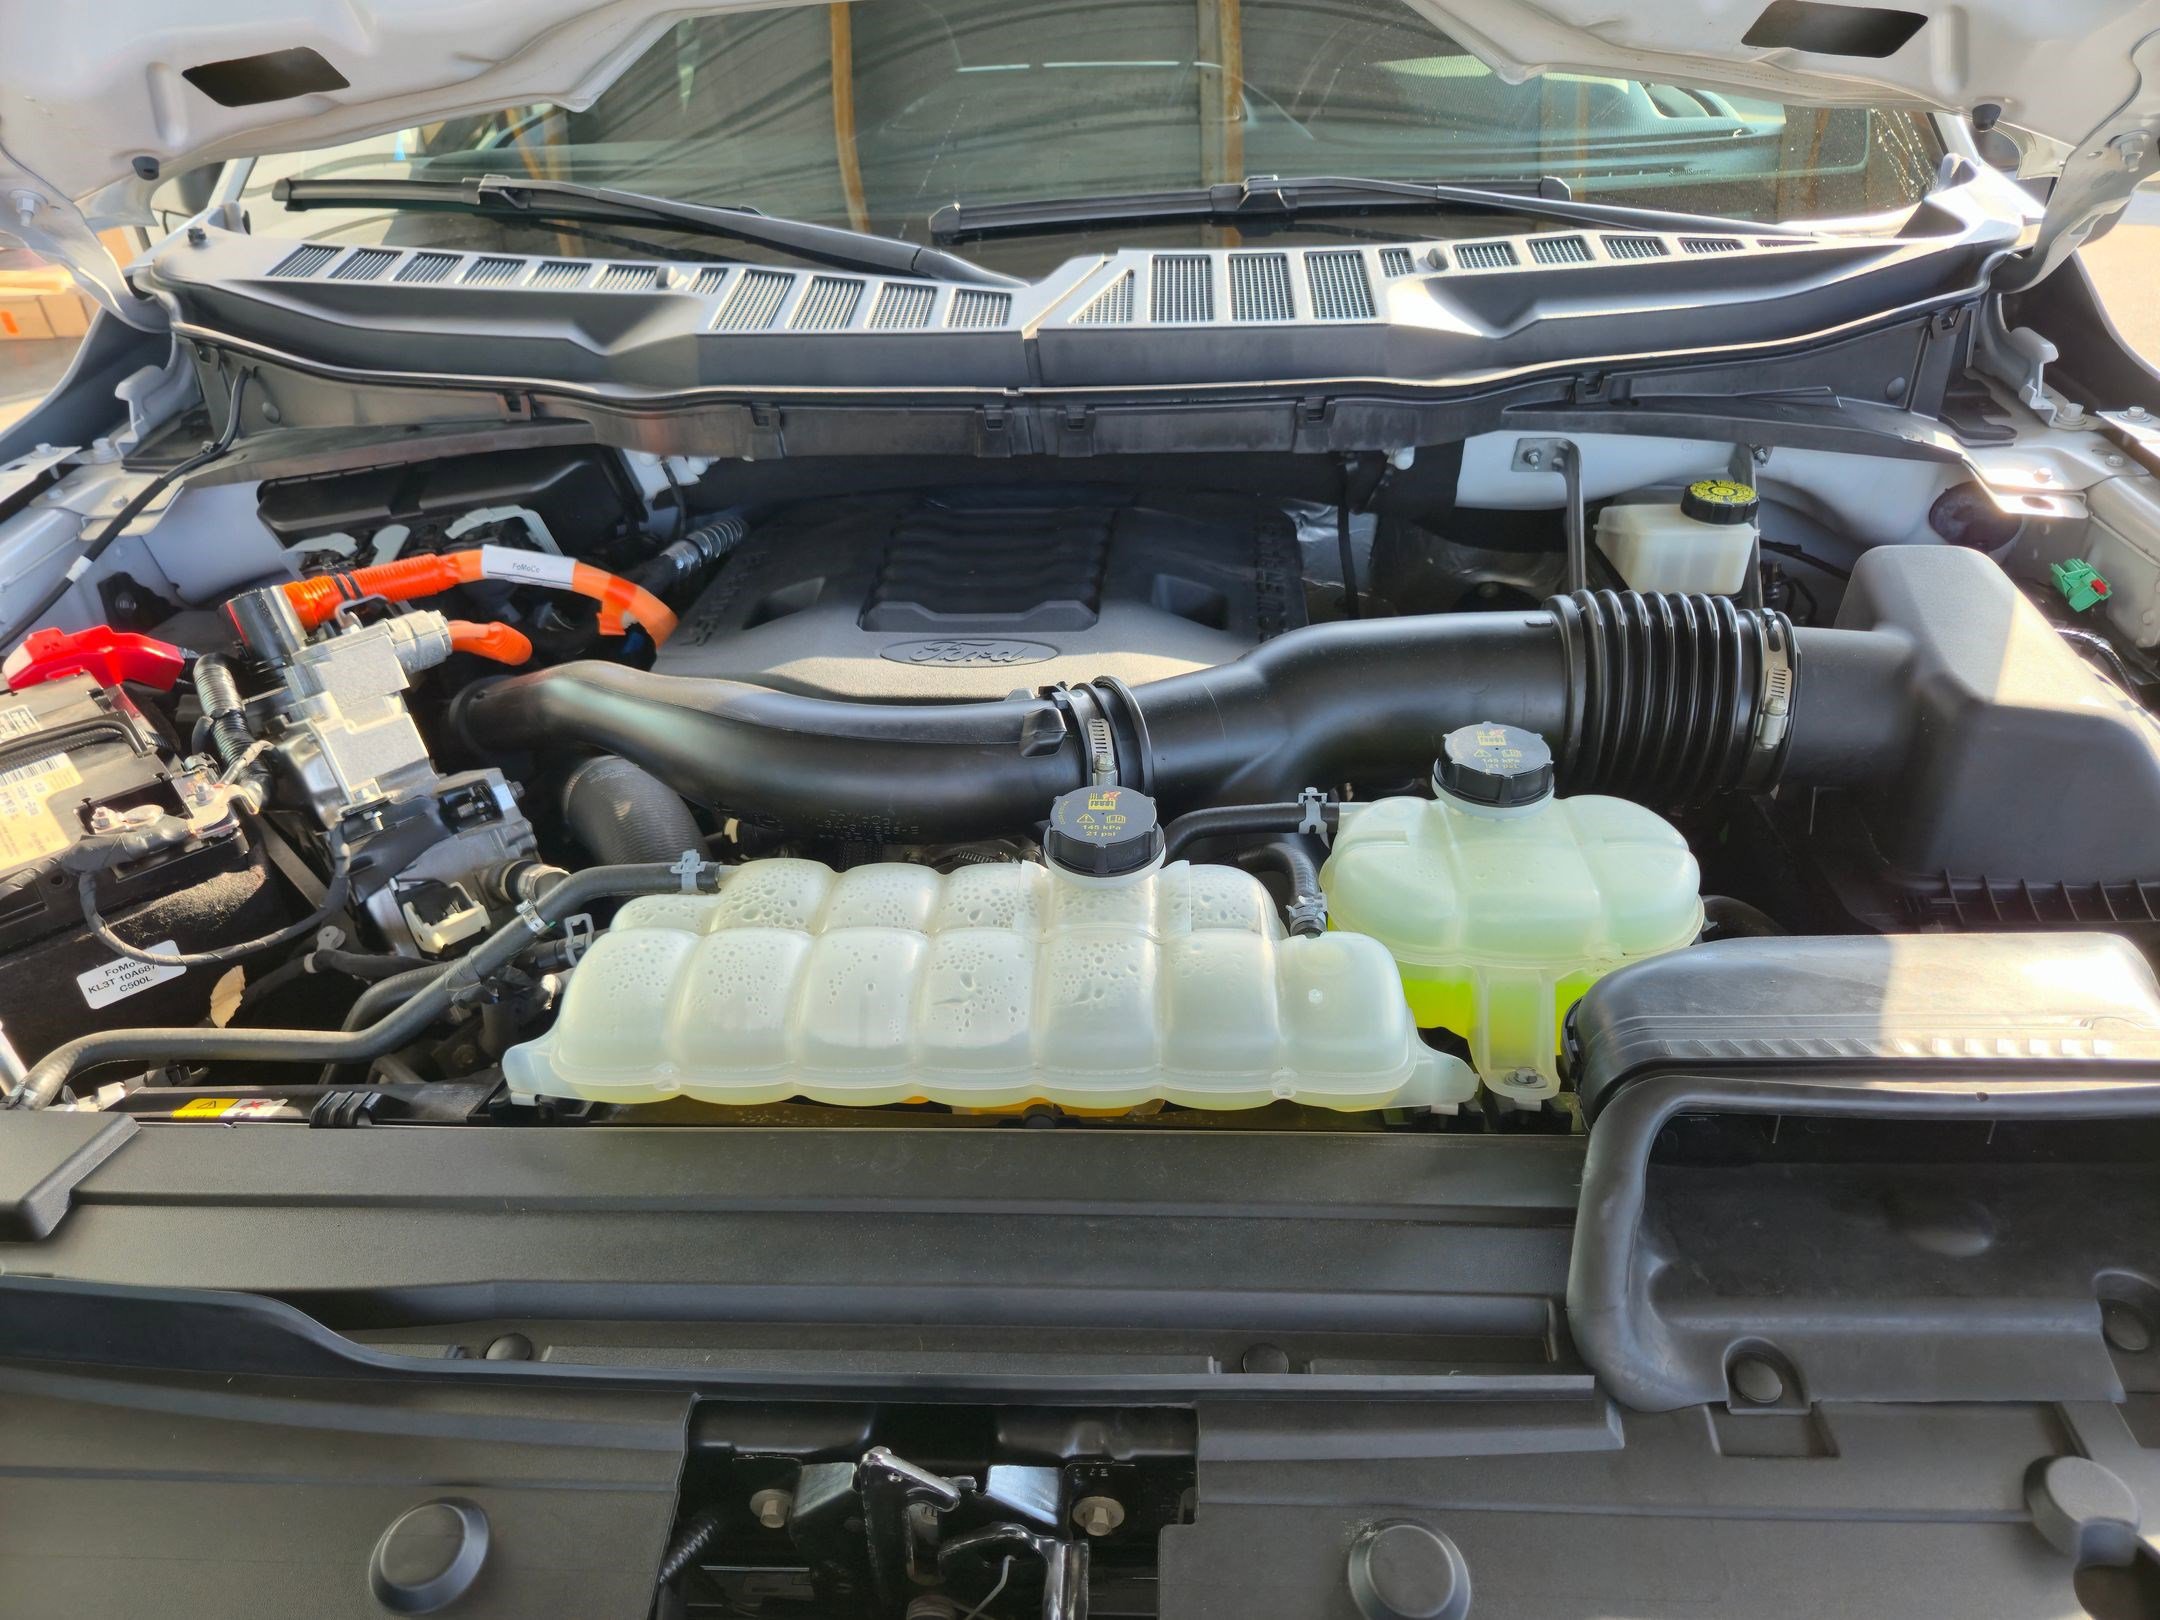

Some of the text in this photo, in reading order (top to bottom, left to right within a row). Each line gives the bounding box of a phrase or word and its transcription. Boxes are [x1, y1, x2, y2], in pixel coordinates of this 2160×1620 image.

[512, 563, 540, 573] FoMoCo
[909, 641, 1027, 663] Ford
[104, 960, 142, 976] FoMo
[88, 965, 155, 993] KL3T 10A687
[120, 976, 152, 992] C500L
